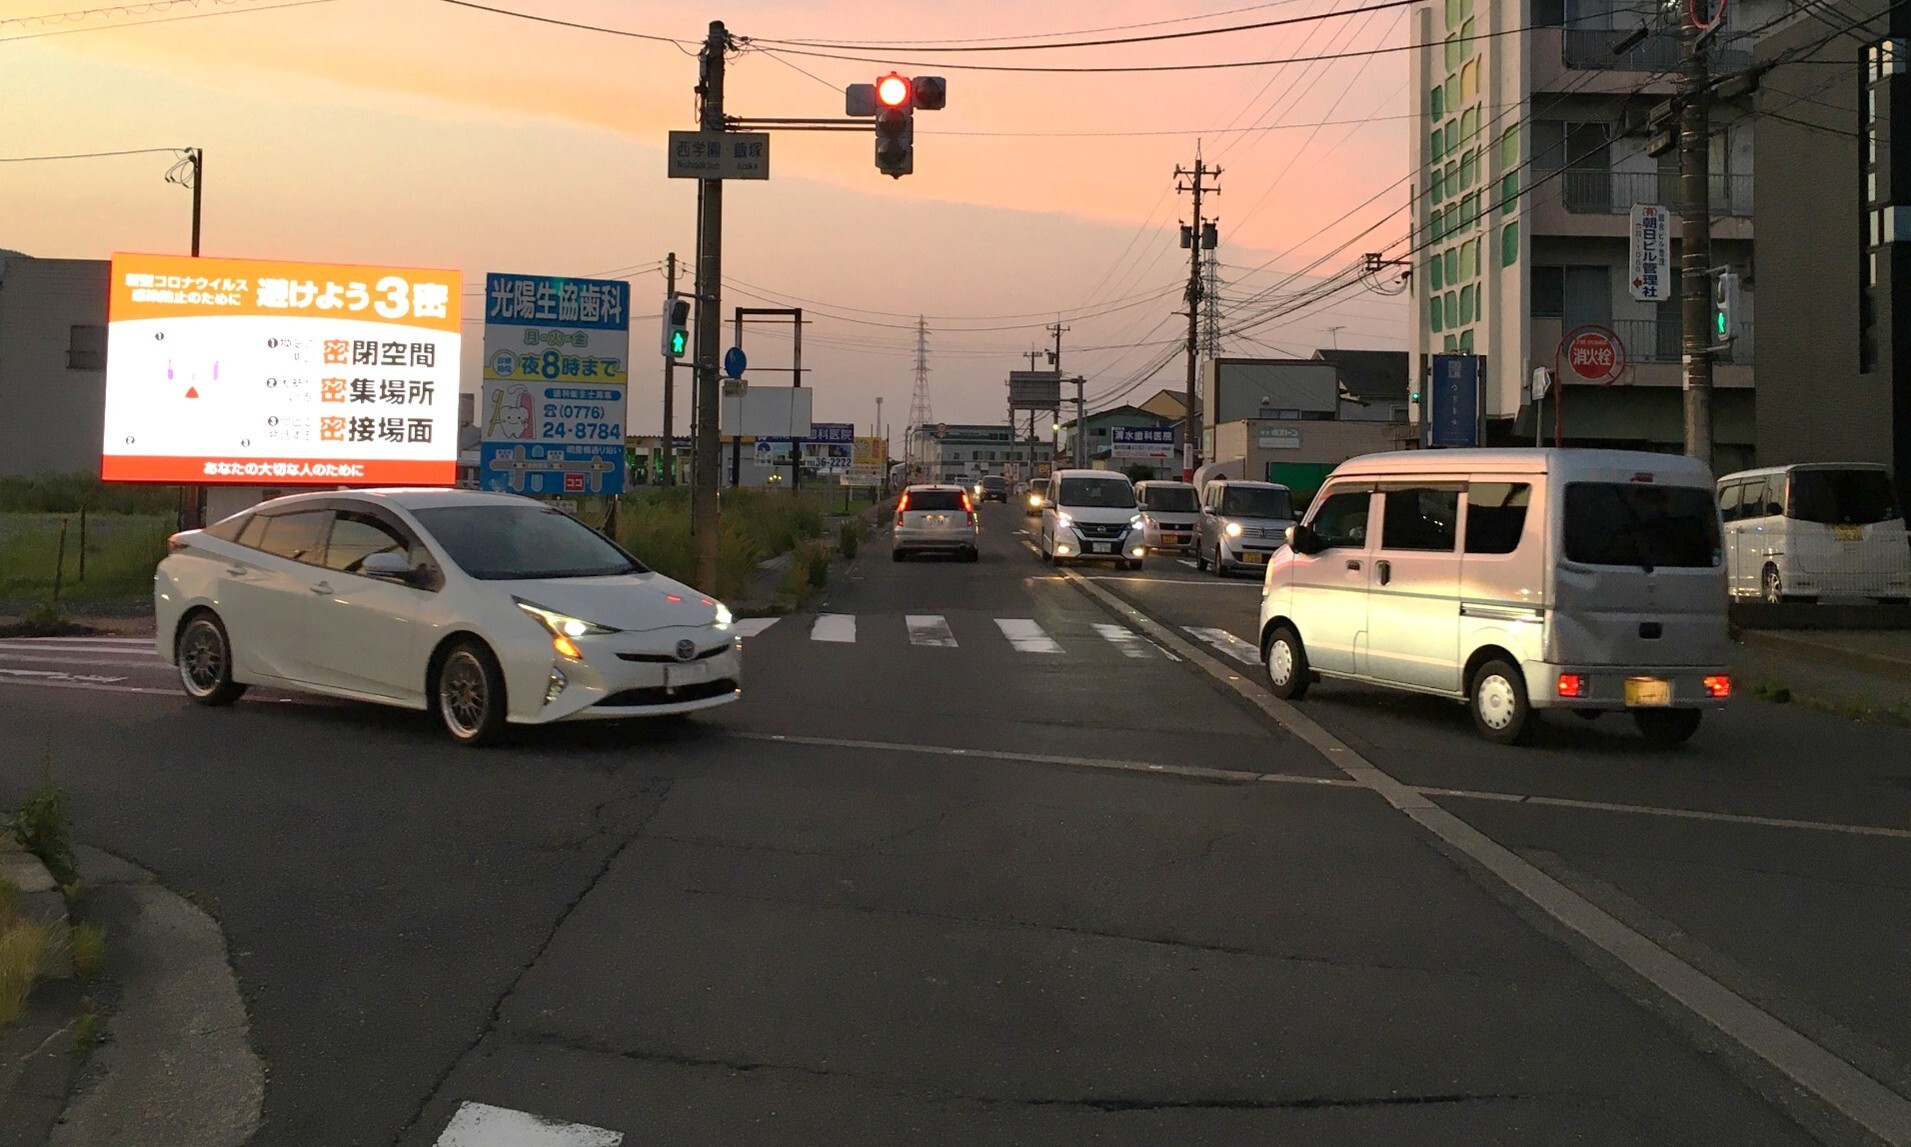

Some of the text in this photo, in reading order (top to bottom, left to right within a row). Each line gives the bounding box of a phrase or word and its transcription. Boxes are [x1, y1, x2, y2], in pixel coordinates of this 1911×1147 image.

[491, 278, 622, 324] 光陽生協歯科
[323, 338, 435, 368] 密閉空間
[521, 351, 618, 379] 夜8時まで
[1573, 347, 1612, 366] 消火栓
[321, 377, 434, 406] 密集場所
[320, 415, 433, 443] 密接場面
[203, 461, 364, 477] あなたの大切な人のために
[815, 458, 852, 467] 36-2222
